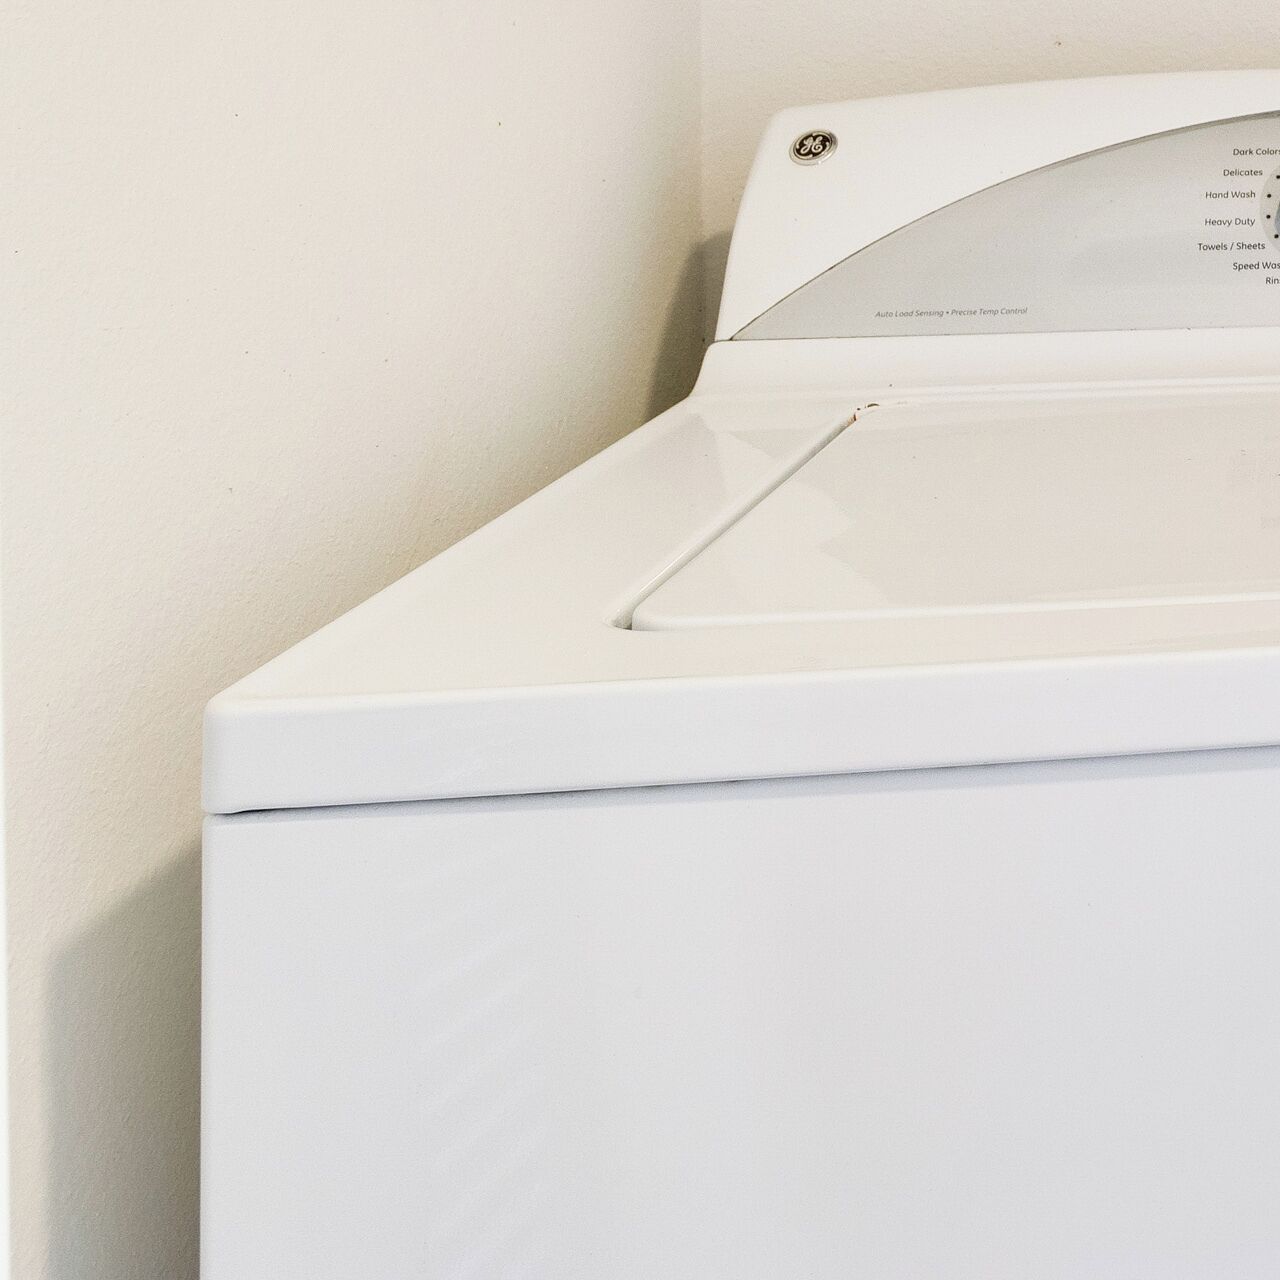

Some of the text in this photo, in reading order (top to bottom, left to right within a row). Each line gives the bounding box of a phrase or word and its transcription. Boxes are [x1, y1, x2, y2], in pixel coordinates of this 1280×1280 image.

[1233, 148, 1254, 156] Dark
[1223, 169, 1263, 177] Delicates
[1206, 191, 1256, 199] Hand Wash
[1205, 218, 1256, 226] Heavy Duty
[1198, 242, 1228, 251] Towels
[1237, 242, 1266, 250] Sheets
[1233, 262, 1260, 271] Speed
[915, 310, 944, 318] Sensing
[979, 308, 999, 317] Temp
[1000, 307, 1028, 315] Control
